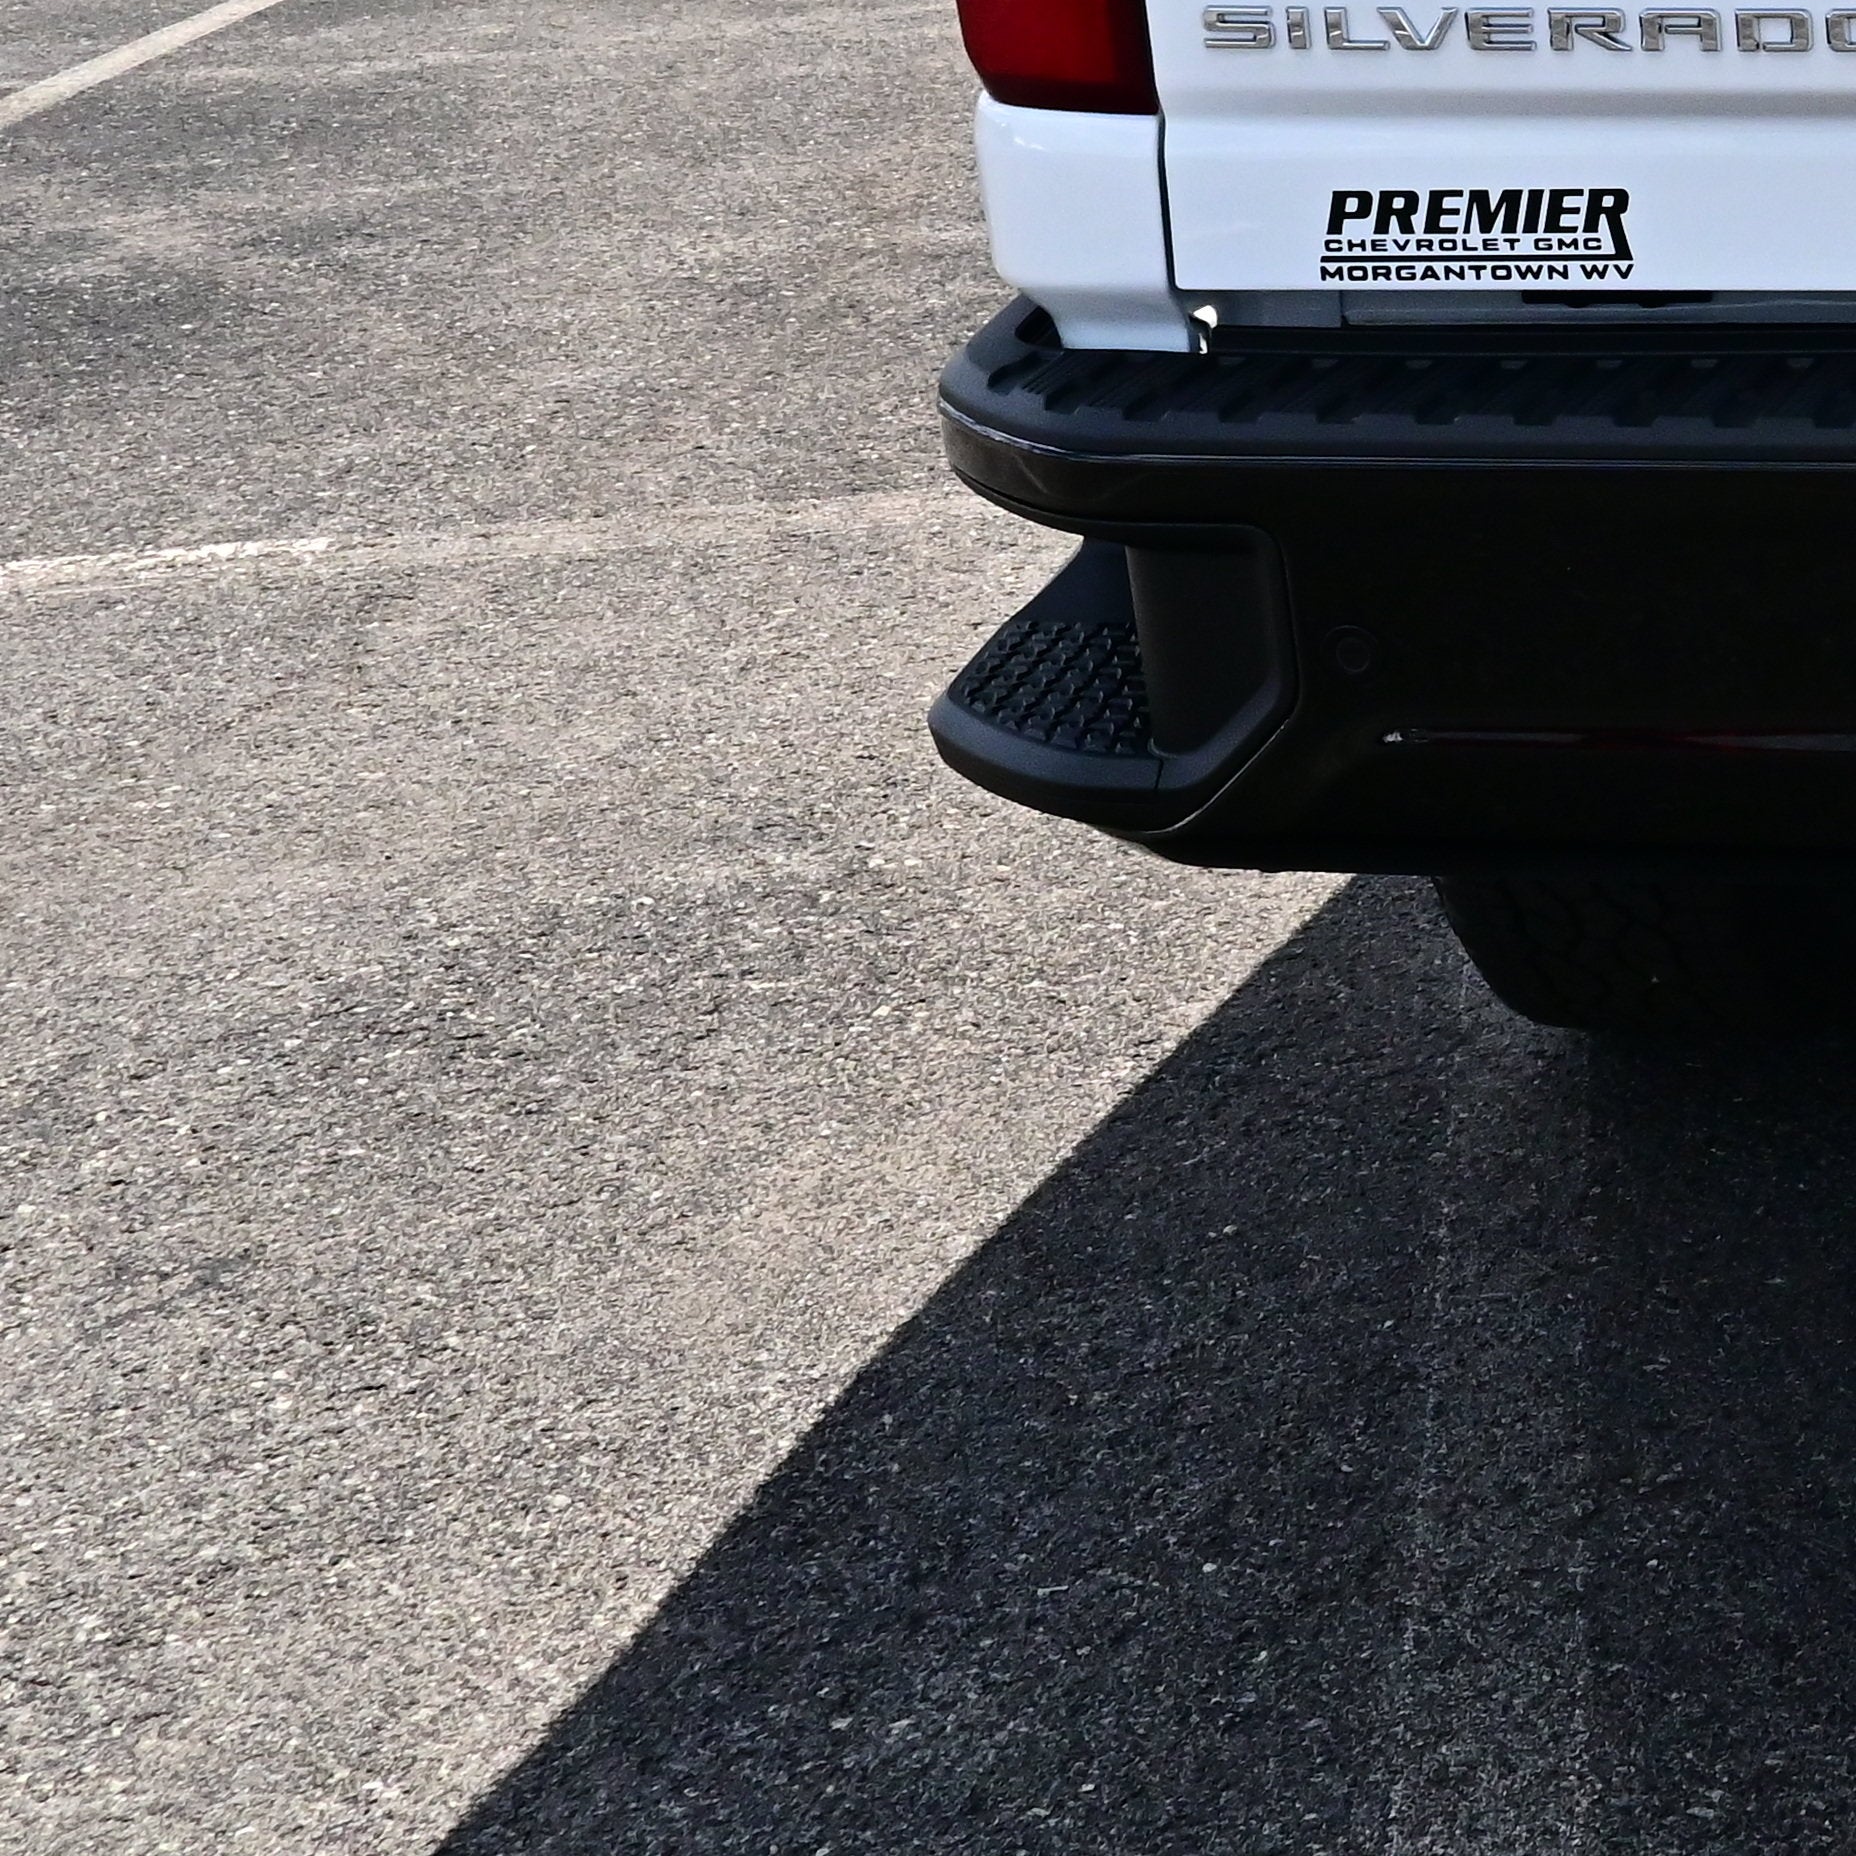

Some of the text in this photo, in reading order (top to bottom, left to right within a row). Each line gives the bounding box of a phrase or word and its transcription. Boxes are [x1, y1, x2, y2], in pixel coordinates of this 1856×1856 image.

[1326, 188, 1633, 235] PREMIER
[1324, 237, 1602, 252] CHEVROLET GMC
[1321, 263, 1634, 281] MORGANTOWN WV
